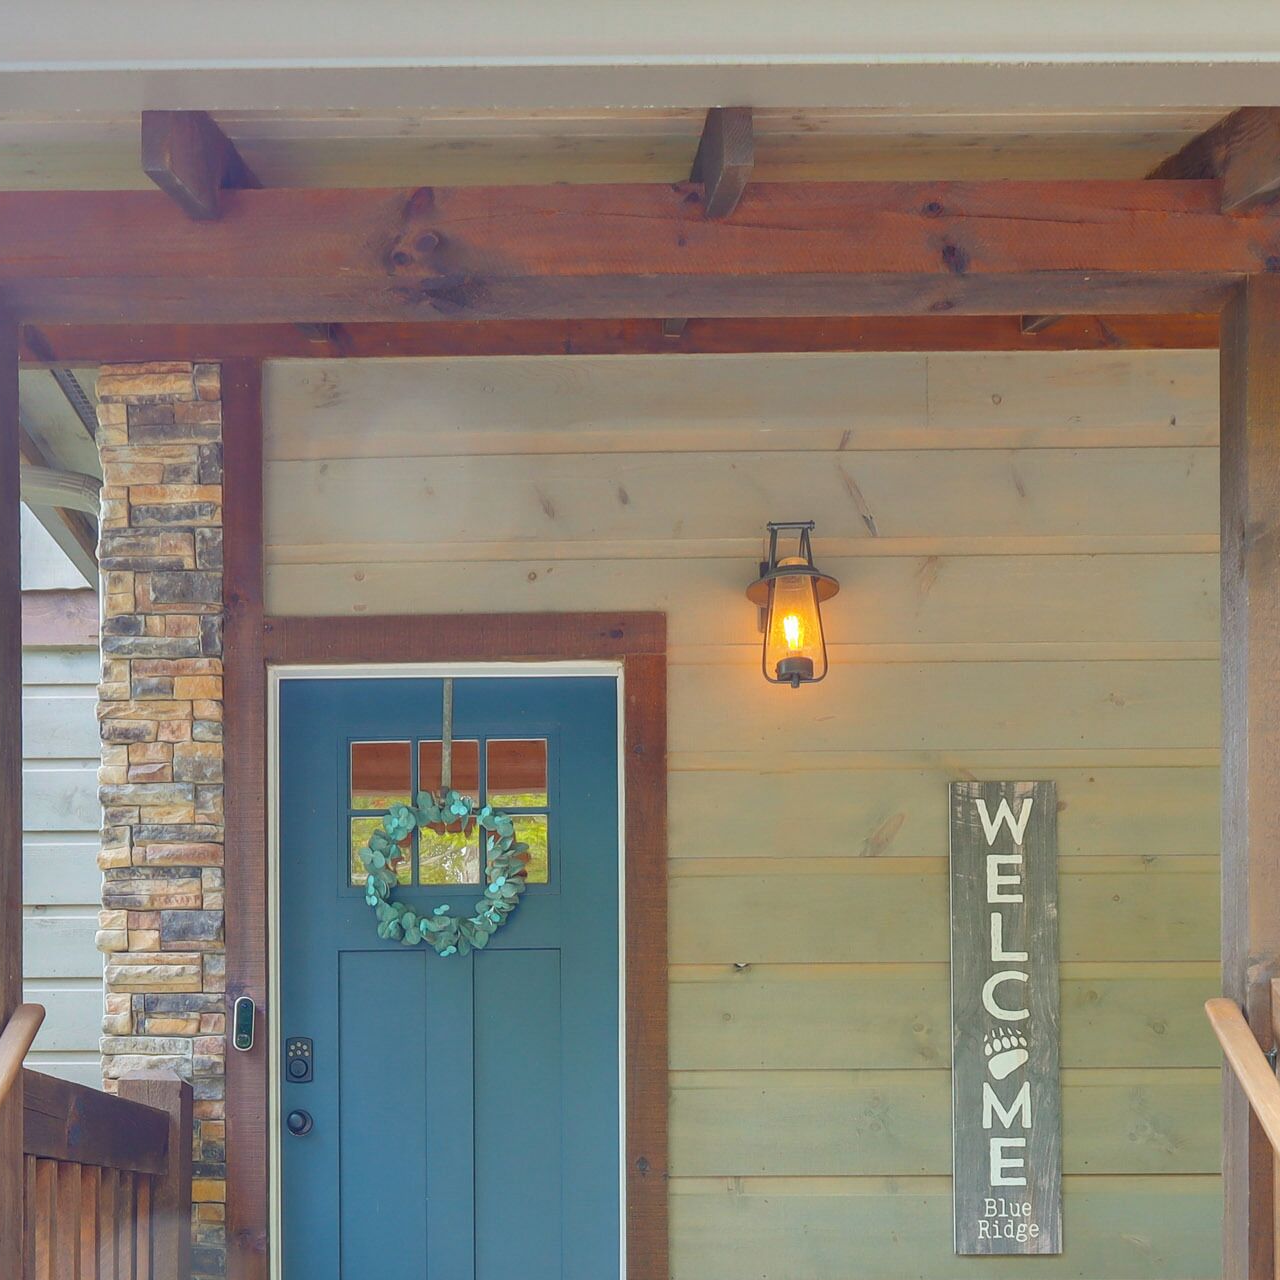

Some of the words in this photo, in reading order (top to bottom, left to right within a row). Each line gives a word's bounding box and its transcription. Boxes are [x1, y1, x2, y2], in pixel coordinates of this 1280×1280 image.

[976, 798, 1033, 1187] WELCME
[984, 1198, 1032, 1217] Blue
[978, 1219, 1040, 1242] Ridge
